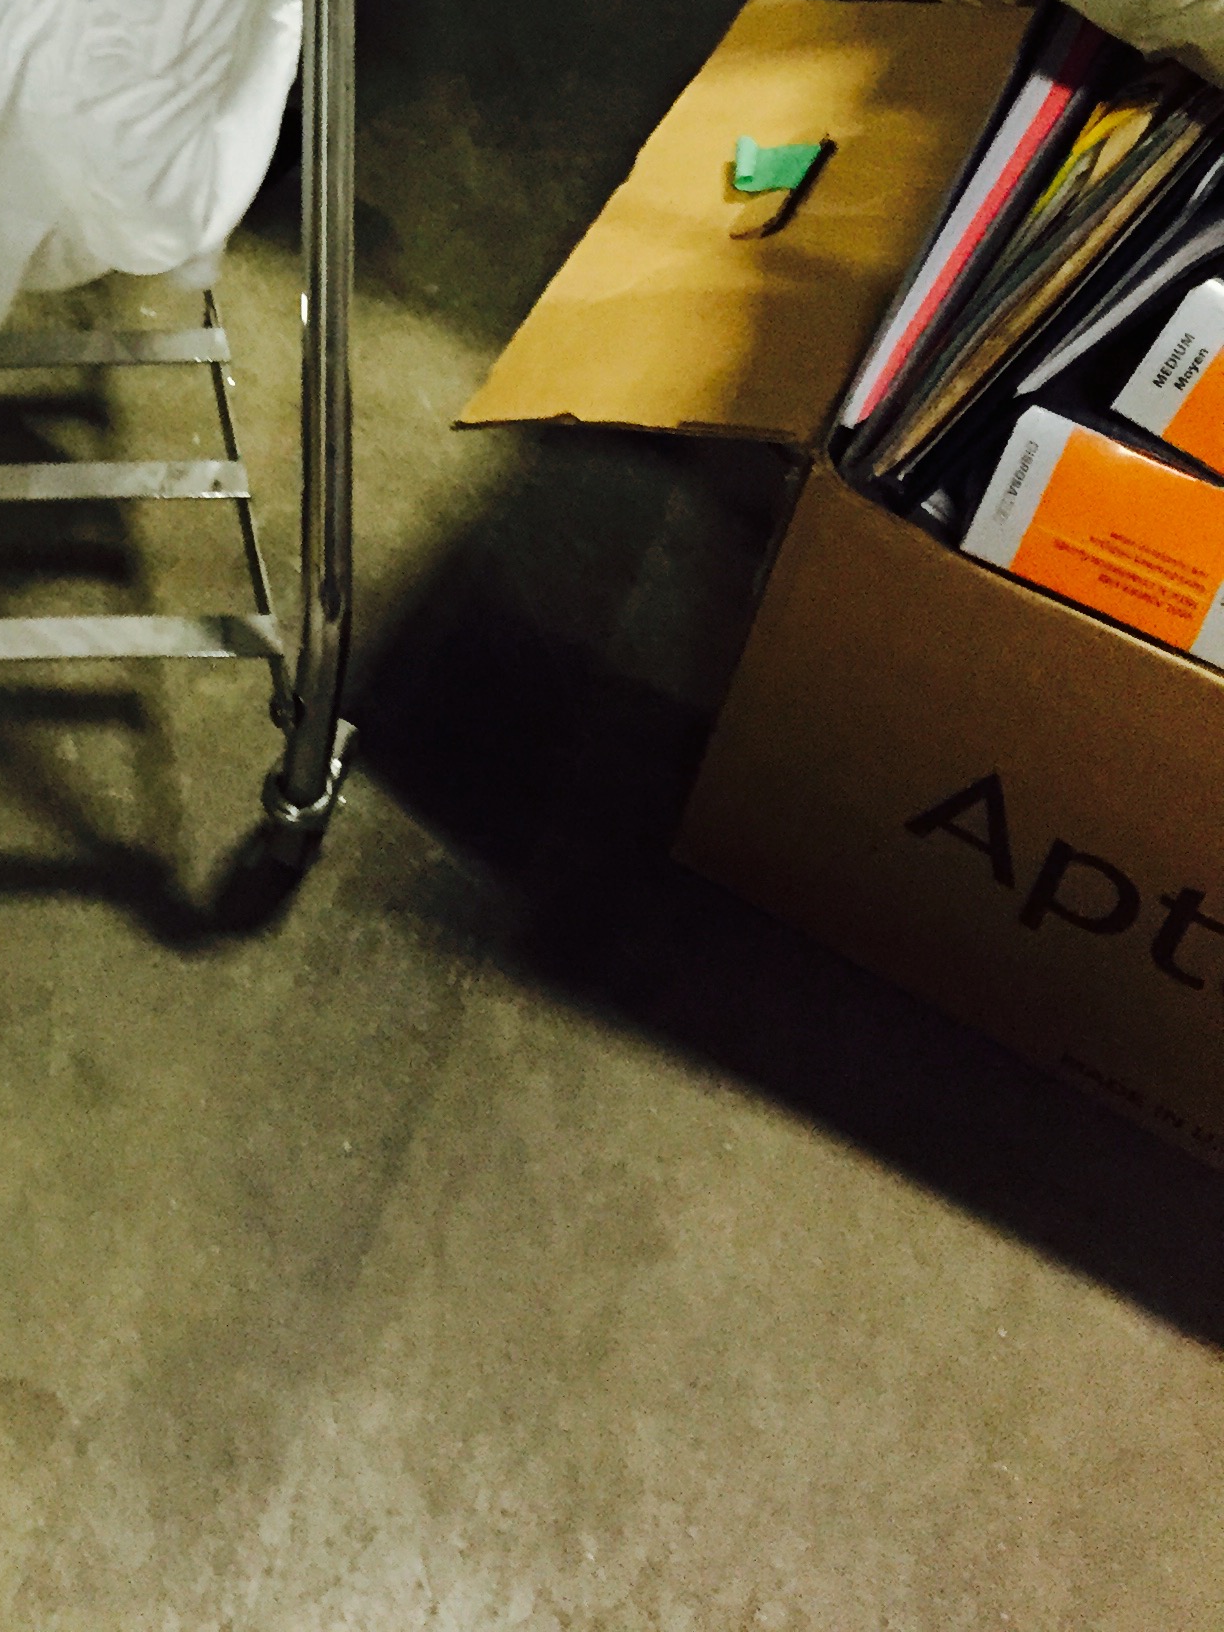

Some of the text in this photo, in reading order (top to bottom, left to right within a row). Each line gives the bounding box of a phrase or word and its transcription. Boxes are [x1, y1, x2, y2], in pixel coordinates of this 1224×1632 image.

[1152, 332, 1196, 389] MEDIUM
[1173, 348, 1209, 391] Moyen
[903, 772, 1224, 1000] Apt
